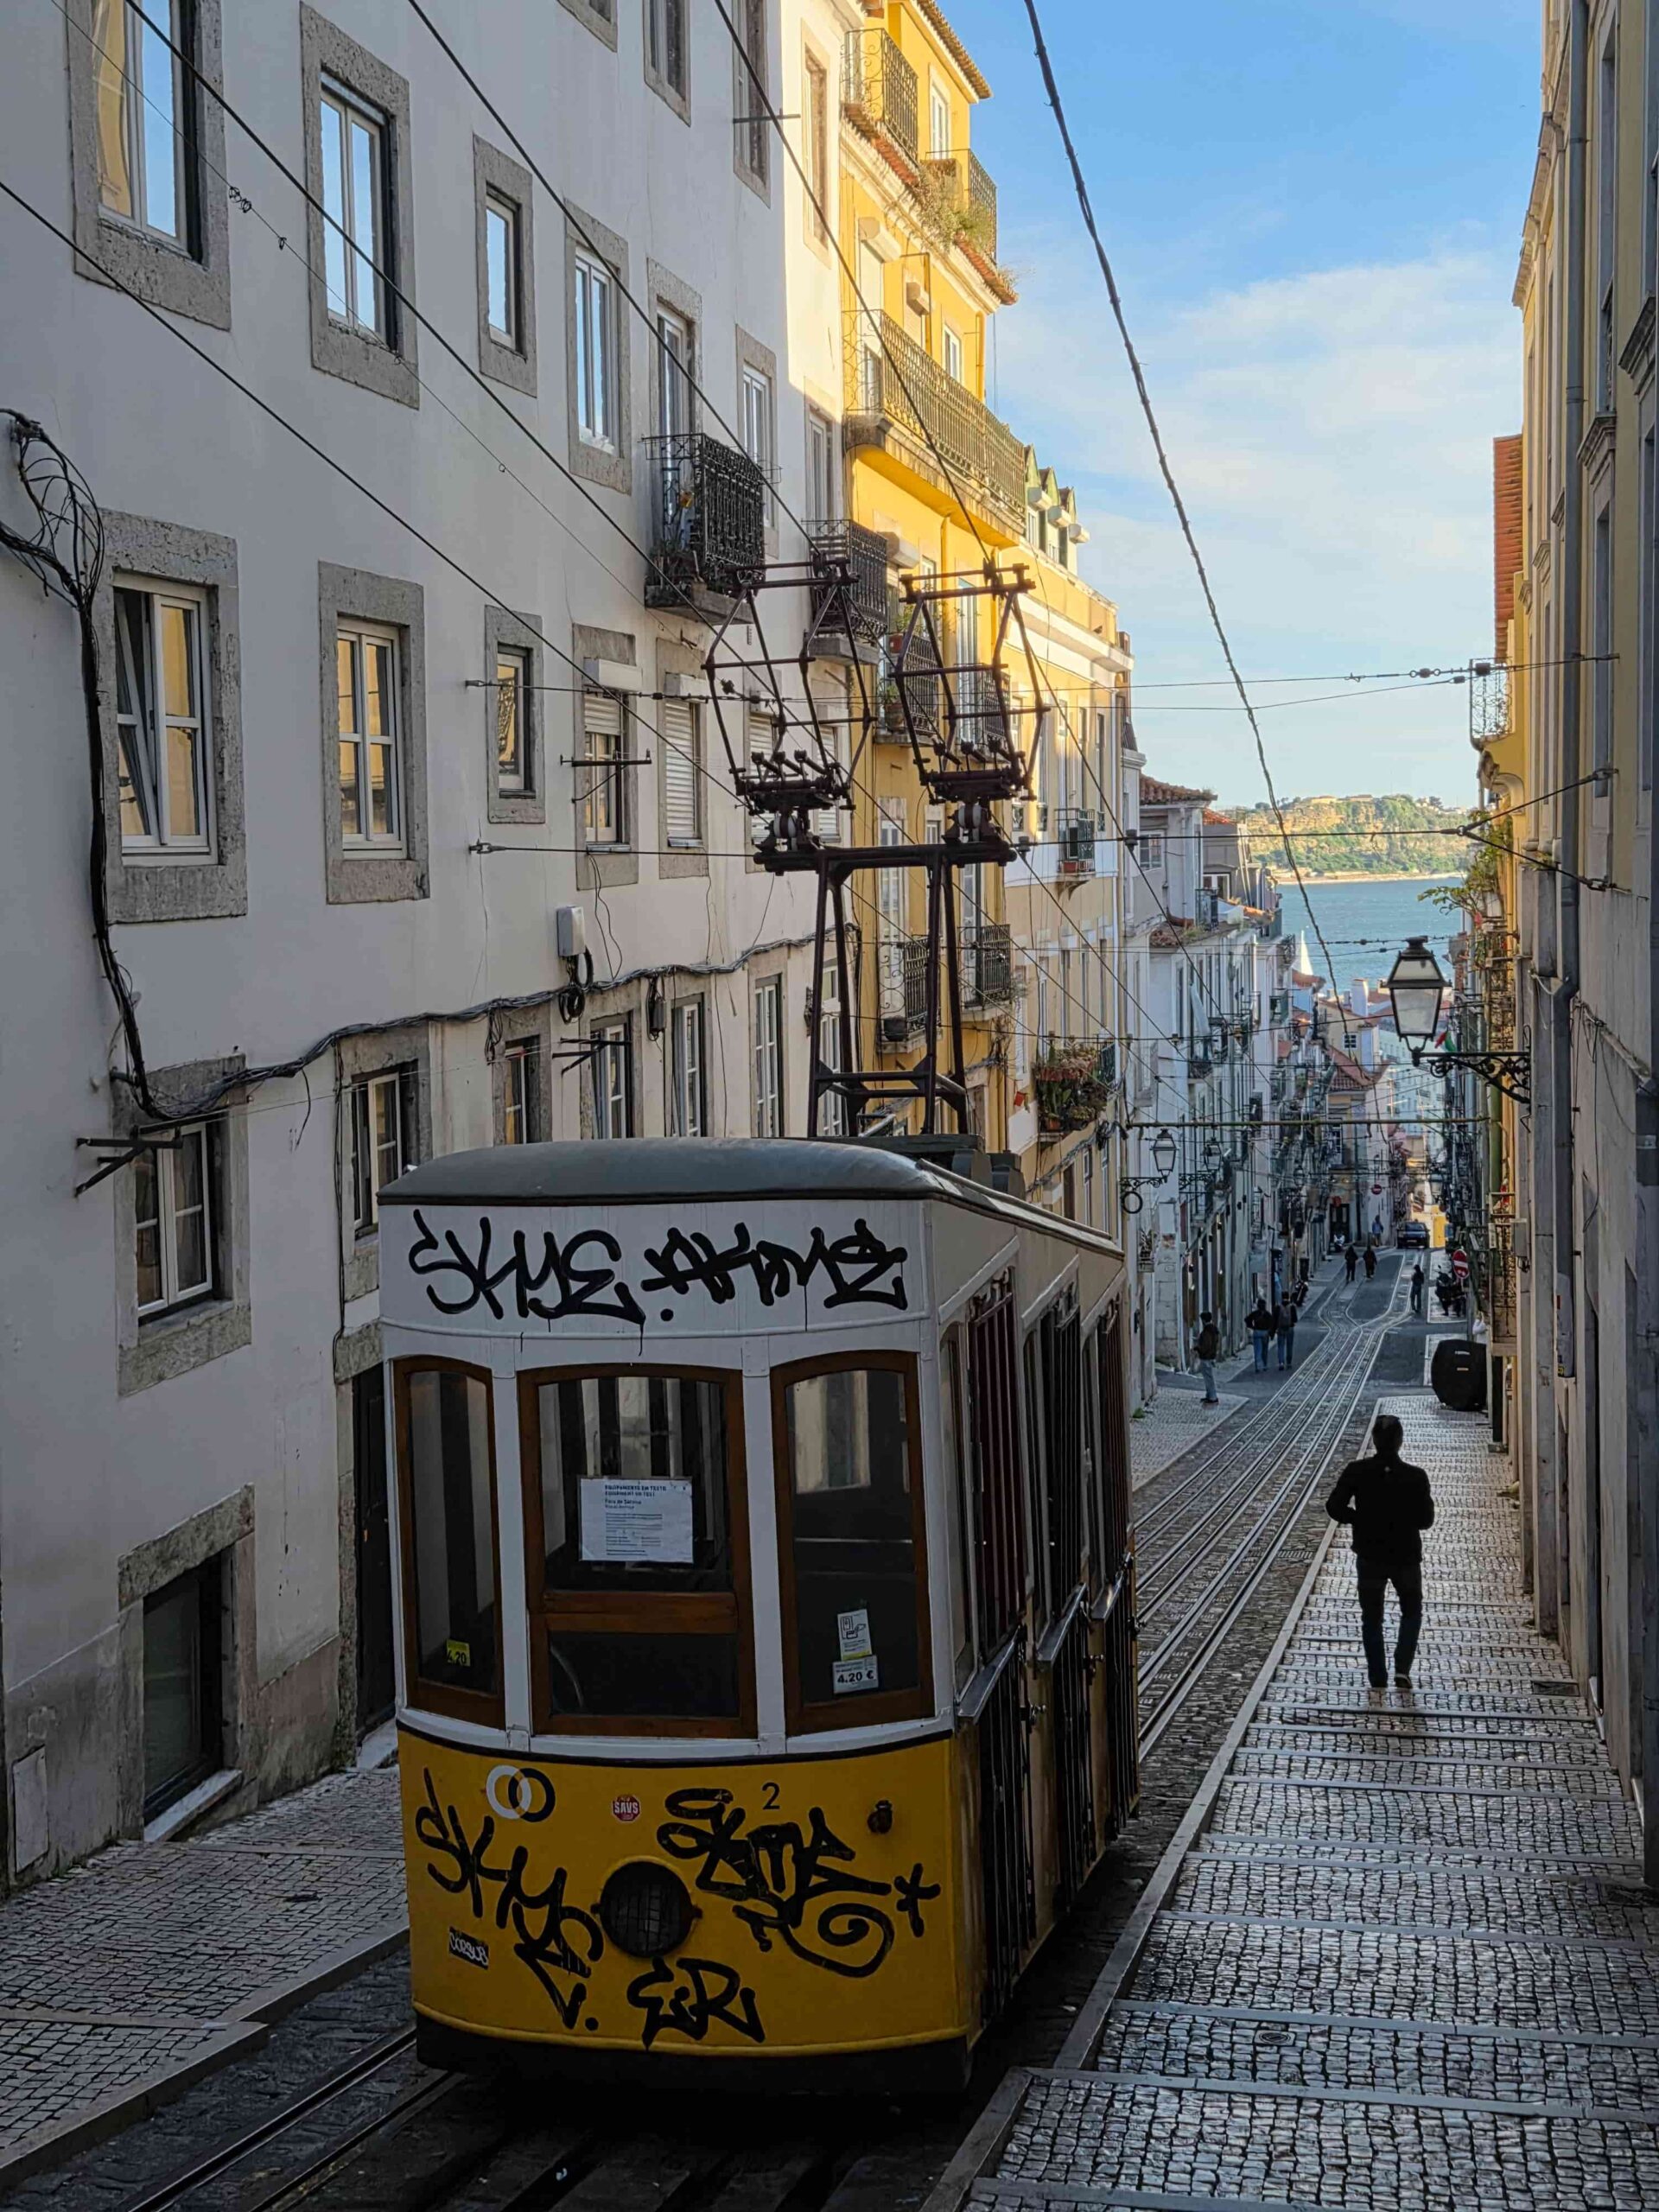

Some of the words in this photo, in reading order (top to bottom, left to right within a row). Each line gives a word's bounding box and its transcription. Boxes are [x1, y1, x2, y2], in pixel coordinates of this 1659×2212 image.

[837, 1671, 862, 1682] 4.20
[867, 1669, 874, 1679] €
[761, 1782, 780, 1810] 2
